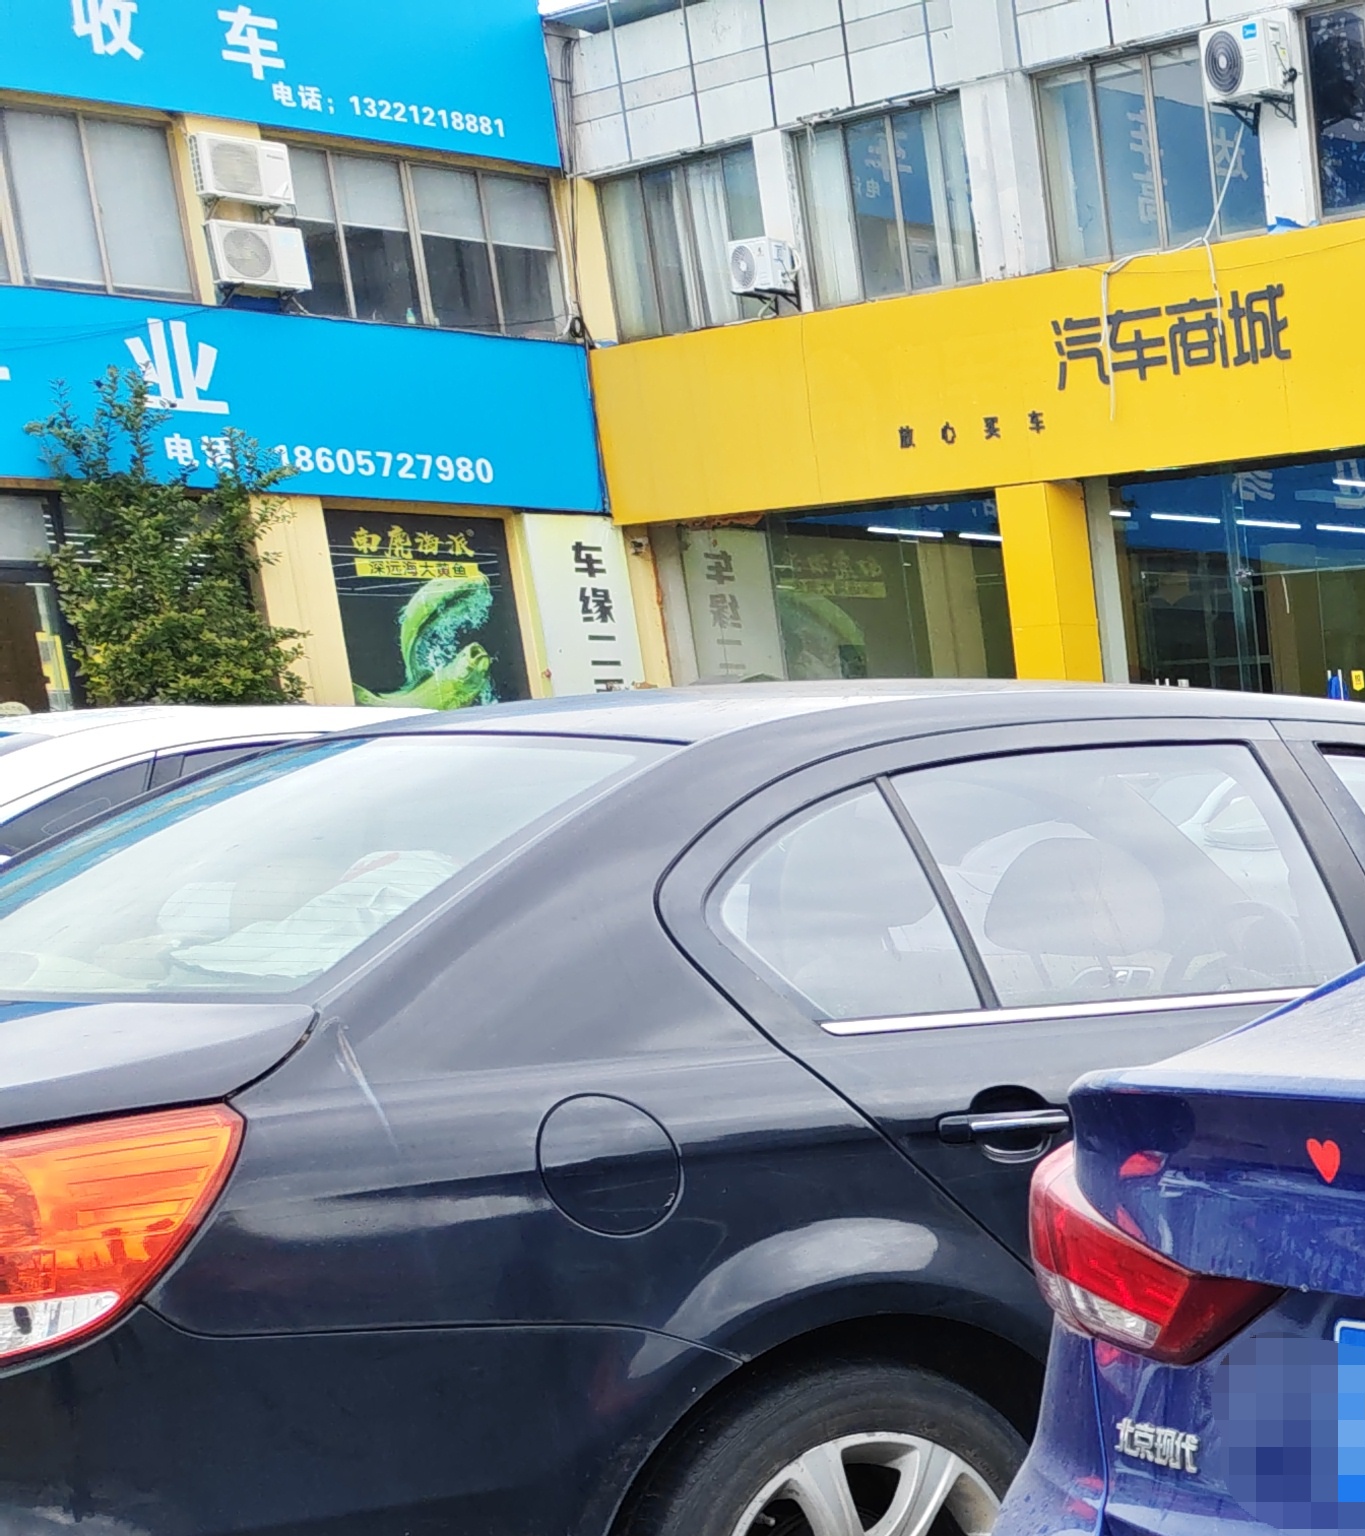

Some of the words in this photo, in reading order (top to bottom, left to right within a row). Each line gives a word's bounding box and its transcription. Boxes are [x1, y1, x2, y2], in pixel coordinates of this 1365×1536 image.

[1051, 283, 1291, 391] 汽车商城
[276, 444, 494, 484] 18605727980
[369, 560, 468, 578] 深远海大黄鱼
[1114, 1416, 1200, 1473] 北京现代
